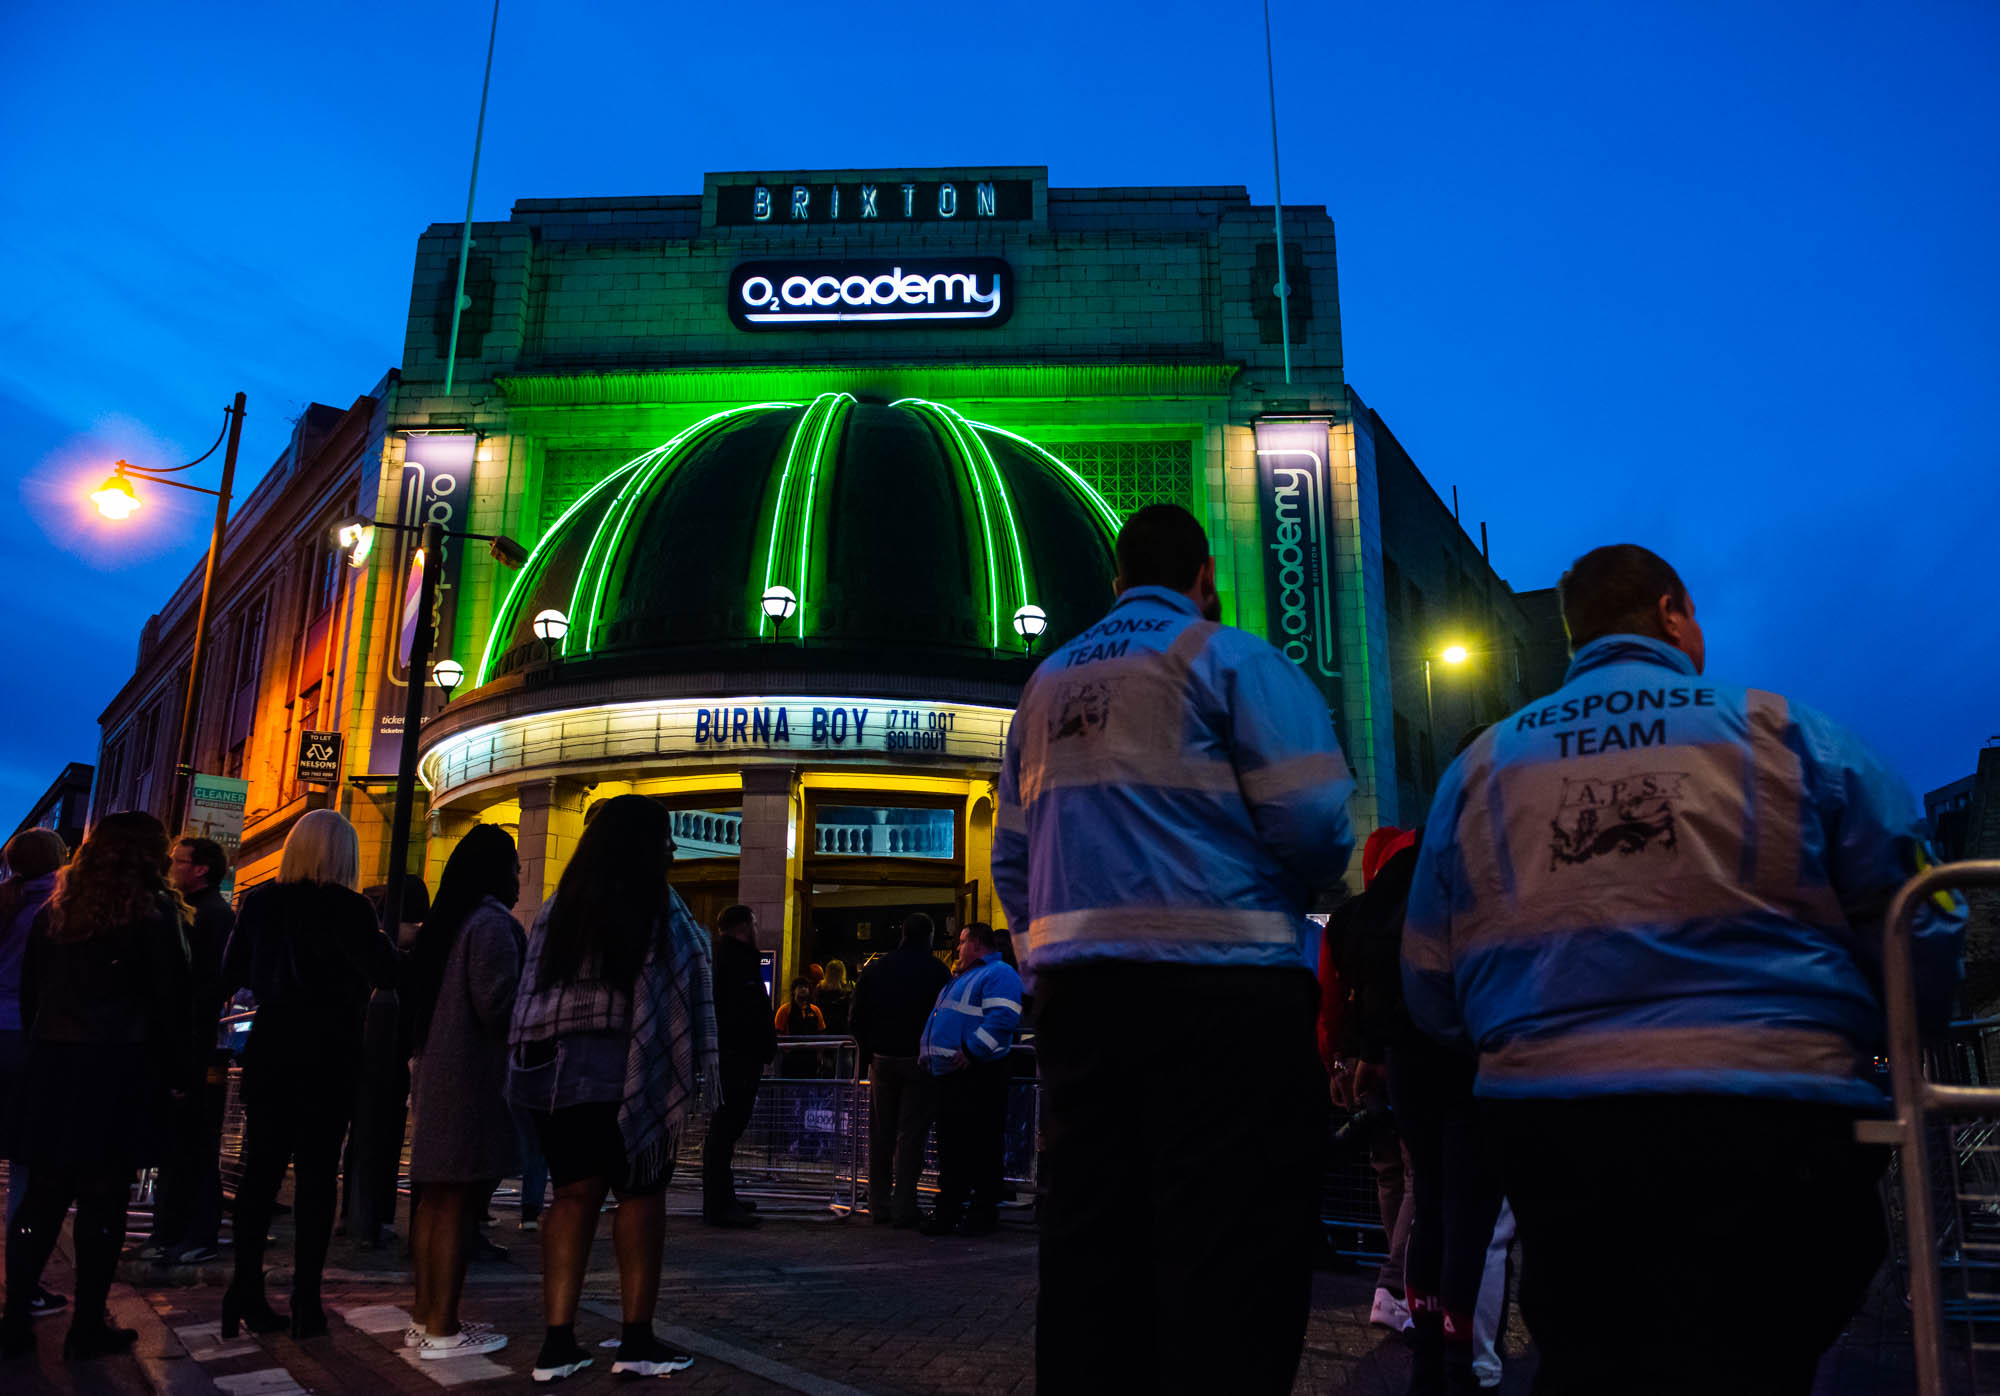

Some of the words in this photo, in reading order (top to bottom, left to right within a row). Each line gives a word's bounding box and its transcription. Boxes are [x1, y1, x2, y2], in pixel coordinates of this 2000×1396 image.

[753, 181, 997, 221] BRIXTON
[1065, 639, 1131, 669] TEAM
[695, 706, 790, 744] BURNA
[812, 706, 869, 744] BOY
[890, 709, 919, 729] 7TH
[1516, 687, 1715, 732] RESPONSE
[1554, 718, 1666, 758] TEAM
[300, 760, 337, 769] NELSONS
[194, 788, 246, 803] CLEANER
